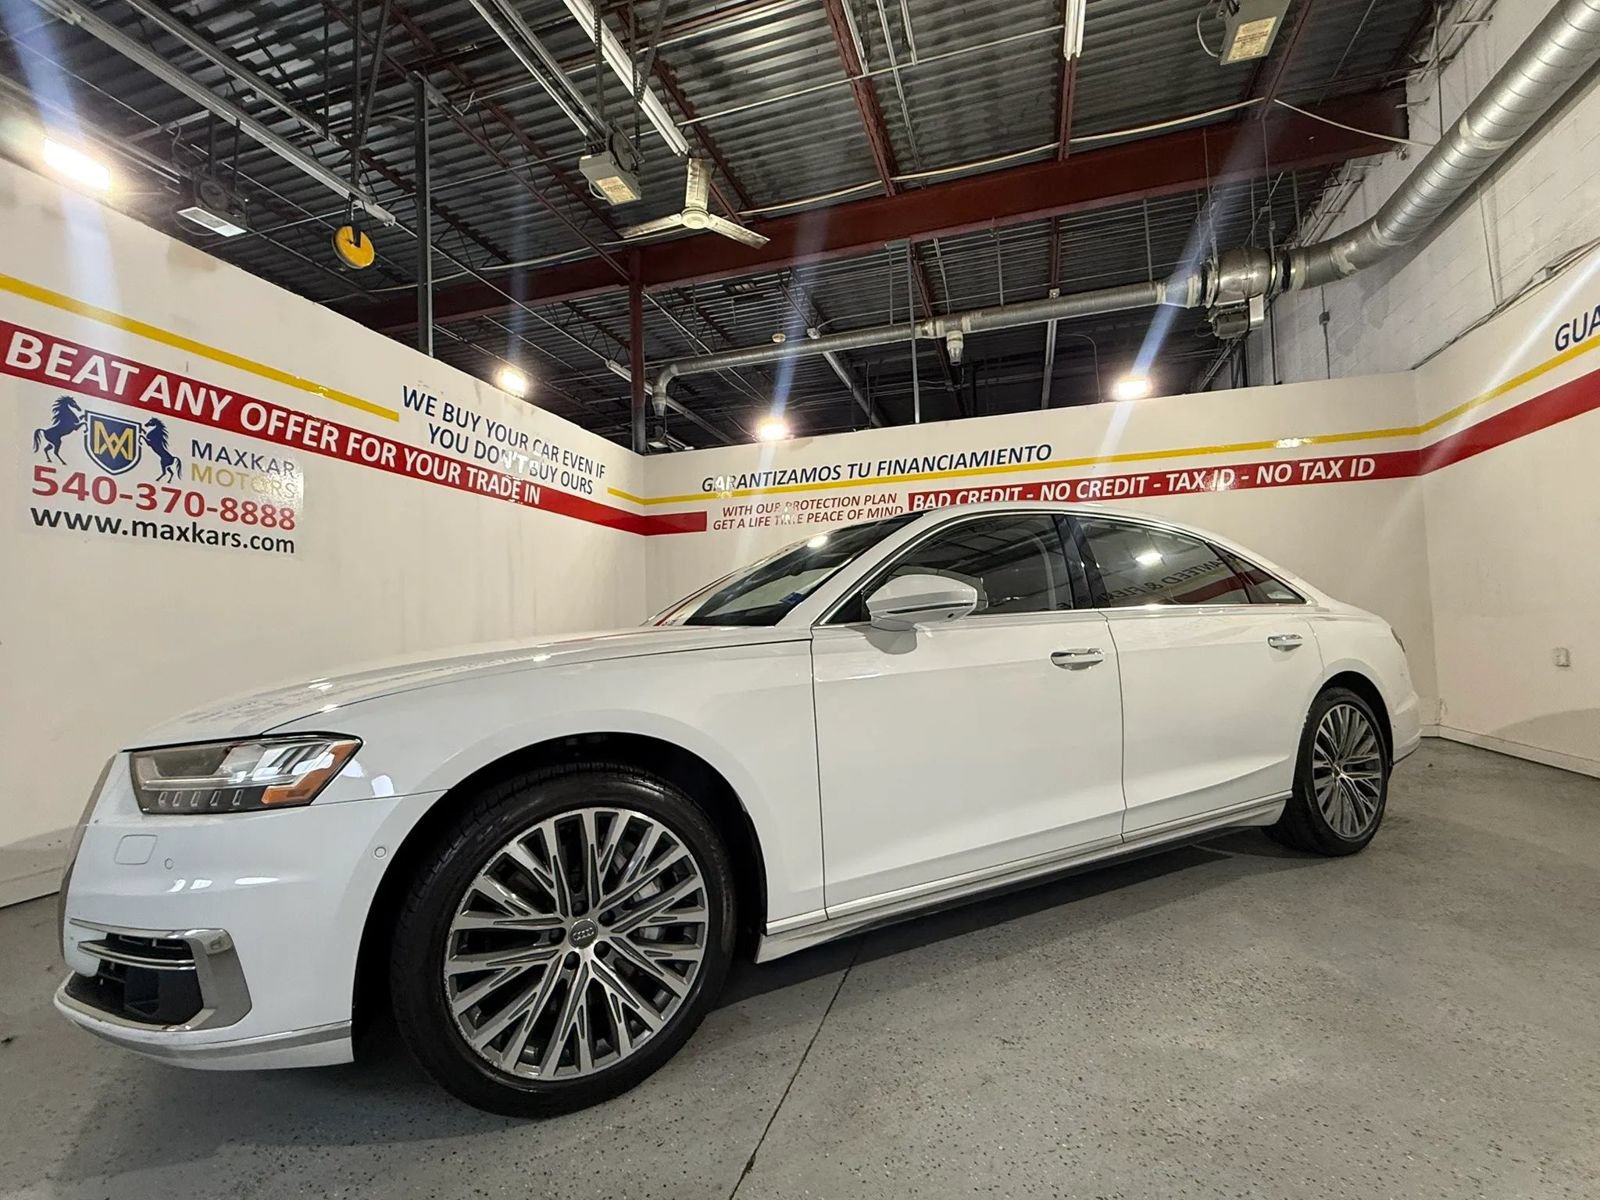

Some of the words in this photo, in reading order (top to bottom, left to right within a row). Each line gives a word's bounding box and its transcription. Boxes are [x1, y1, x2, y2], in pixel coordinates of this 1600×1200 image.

[5, 331, 139, 396] BEAT
[139, 374, 233, 422] ANY
[240, 401, 340, 453] OFFER
[346, 431, 397, 468] FOR
[404, 448, 462, 485] YOUR
[466, 466, 522, 500] TRADE
[524, 484, 541, 505] IN
[403, 385, 437, 417] WE
[442, 402, 481, 432] BUY
[486, 418, 529, 451] YOUR
[532, 439, 559, 463] CAR
[562, 450, 594, 475] EVEN
[595, 463, 606, 479] IF
[191, 439, 295, 479] MAXKAR
[191, 463, 296, 499] MOTORS
[428, 423, 469, 454] YOU
[474, 440, 529, 474] DON'T
[529, 460, 558, 483] BUY
[561, 471, 593, 495] OURS
[702, 464, 842, 493] GARANTIZAMOS
[847, 462, 872, 479] TU
[877, 443, 1053, 476] FINANCIAMIENTO
[912, 493, 950, 511] BAD
[955, 487, 1023, 505] CREDIT
[1040, 482, 1071, 501] NO
[1076, 475, 1150, 499] CREDIT
[1166, 471, 1205, 492] TAX
[1211, 468, 1235, 491] ID
[1256, 463, 1292, 485] NO
[1299, 460, 1344, 481] TAX
[1350, 457, 1376, 478] ID
[31, 464, 297, 531] 540-370-8888
[713, 518, 735, 531] GET
[737, 517, 746, 529] A
[749, 515, 771, 528] LIFE
[807, 511, 846, 524] PEACE
[847, 508, 864, 520] OF
[866, 505, 904, 519] MIND
[722, 504, 752, 518] WITH
[756, 502, 781, 515] OUR
[784, 496, 862, 511] PROTECTION
[863, 493, 897, 506] PLAN
[30, 507, 296, 554] www.maxkars.com
